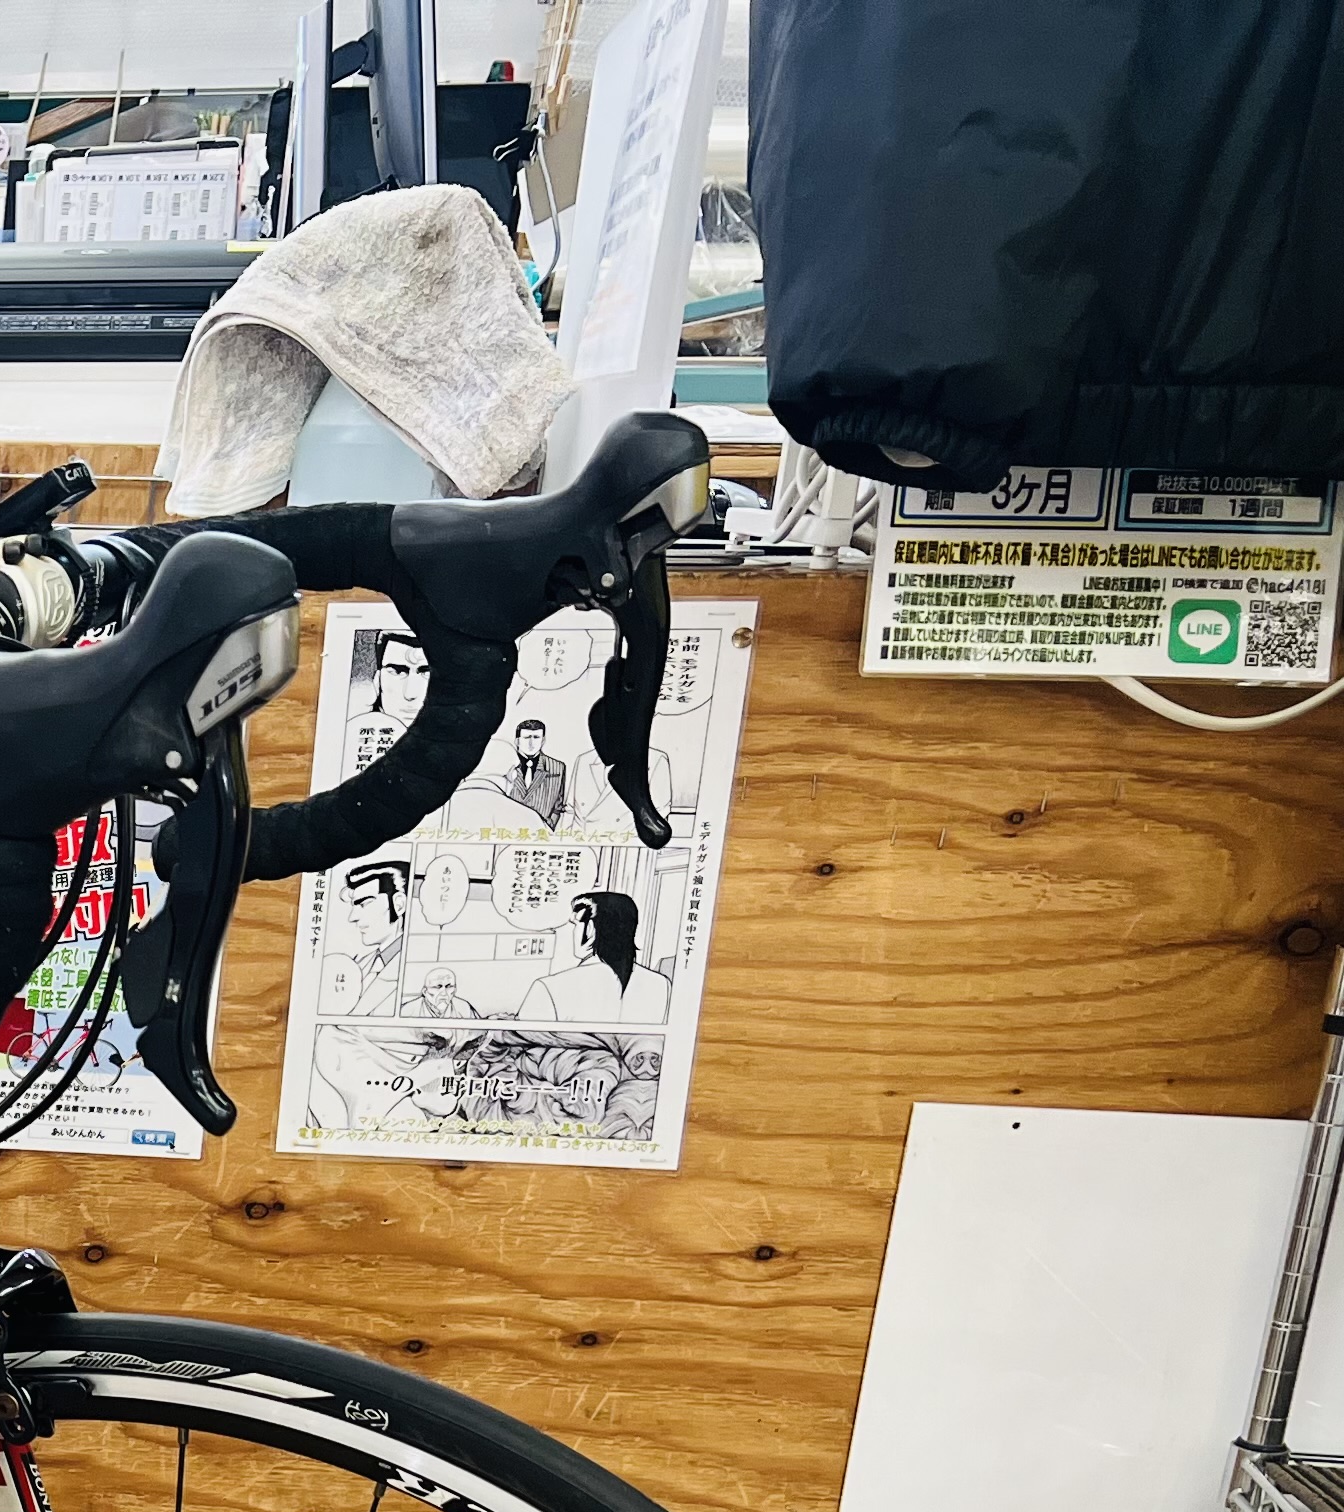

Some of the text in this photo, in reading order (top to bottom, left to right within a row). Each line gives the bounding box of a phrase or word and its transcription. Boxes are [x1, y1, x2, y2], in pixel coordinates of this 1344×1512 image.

[1229, 498, 1284, 518] 1週間
[1186, 622, 1223, 637] LINE
[217, 651, 263, 689] SHIMANO
[198, 664, 264, 721] 105
[334, 973, 346, 995] はい
[51, 1127, 106, 1140] あいひんかん
